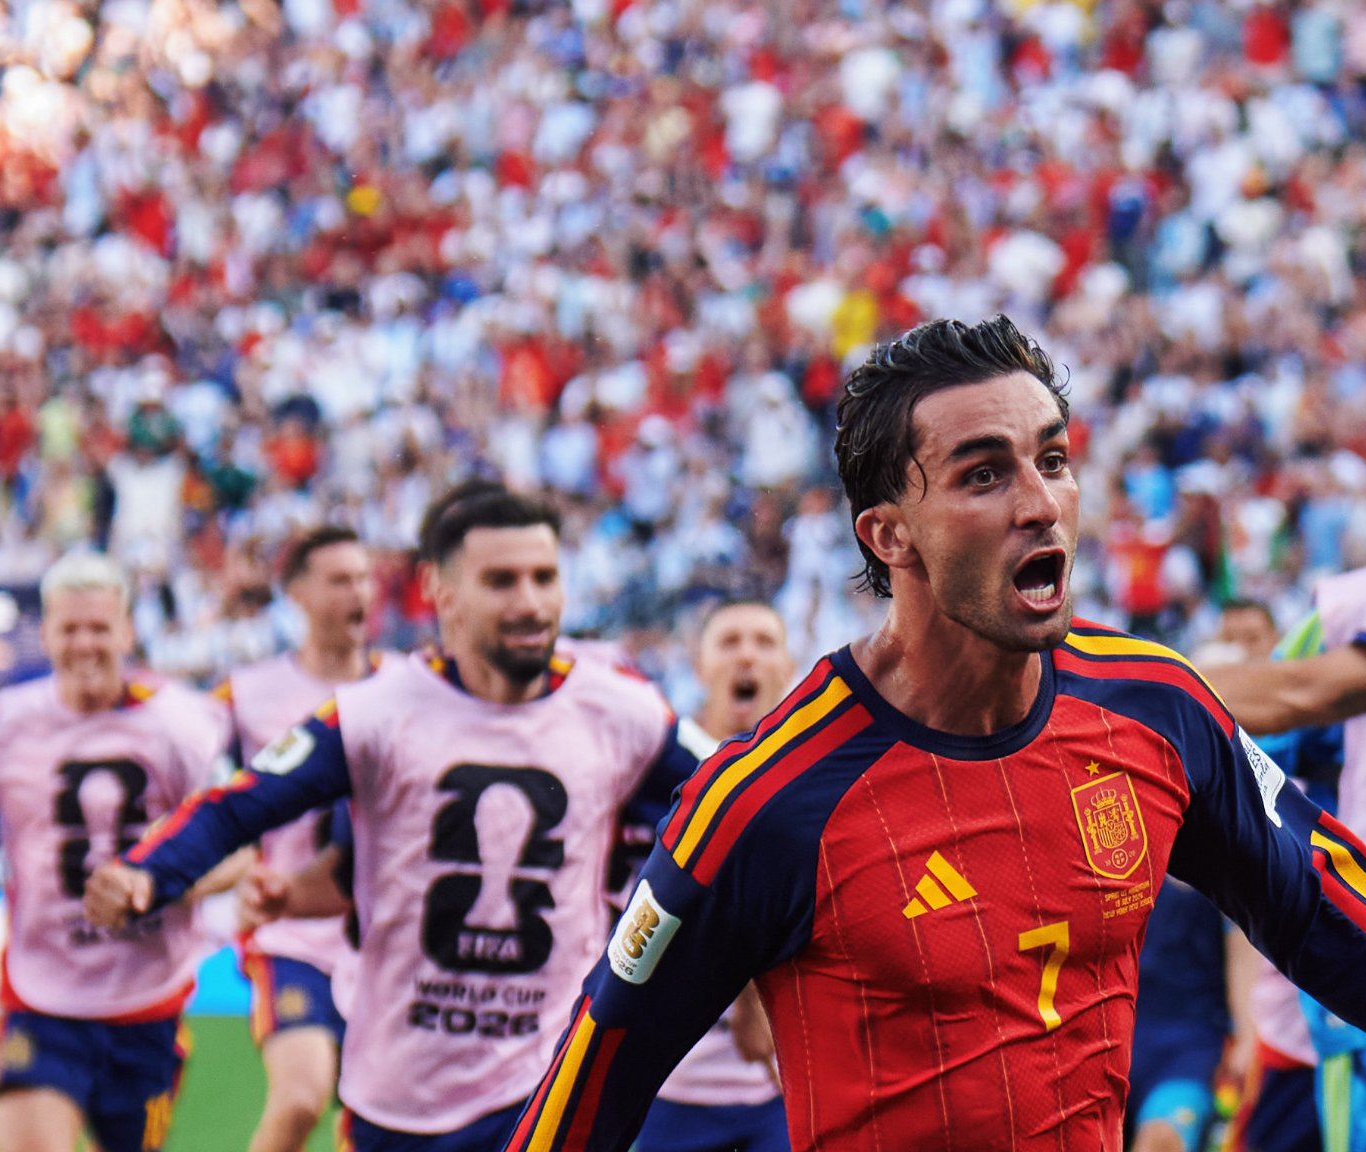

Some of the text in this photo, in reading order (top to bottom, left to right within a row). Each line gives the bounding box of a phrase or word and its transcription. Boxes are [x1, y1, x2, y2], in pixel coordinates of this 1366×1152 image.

[457, 930, 523, 962] FIFA
[415, 977, 546, 1006] WORLD CUP
[1018, 920, 1070, 1032] 7
[408, 1001, 539, 1039] 2026
